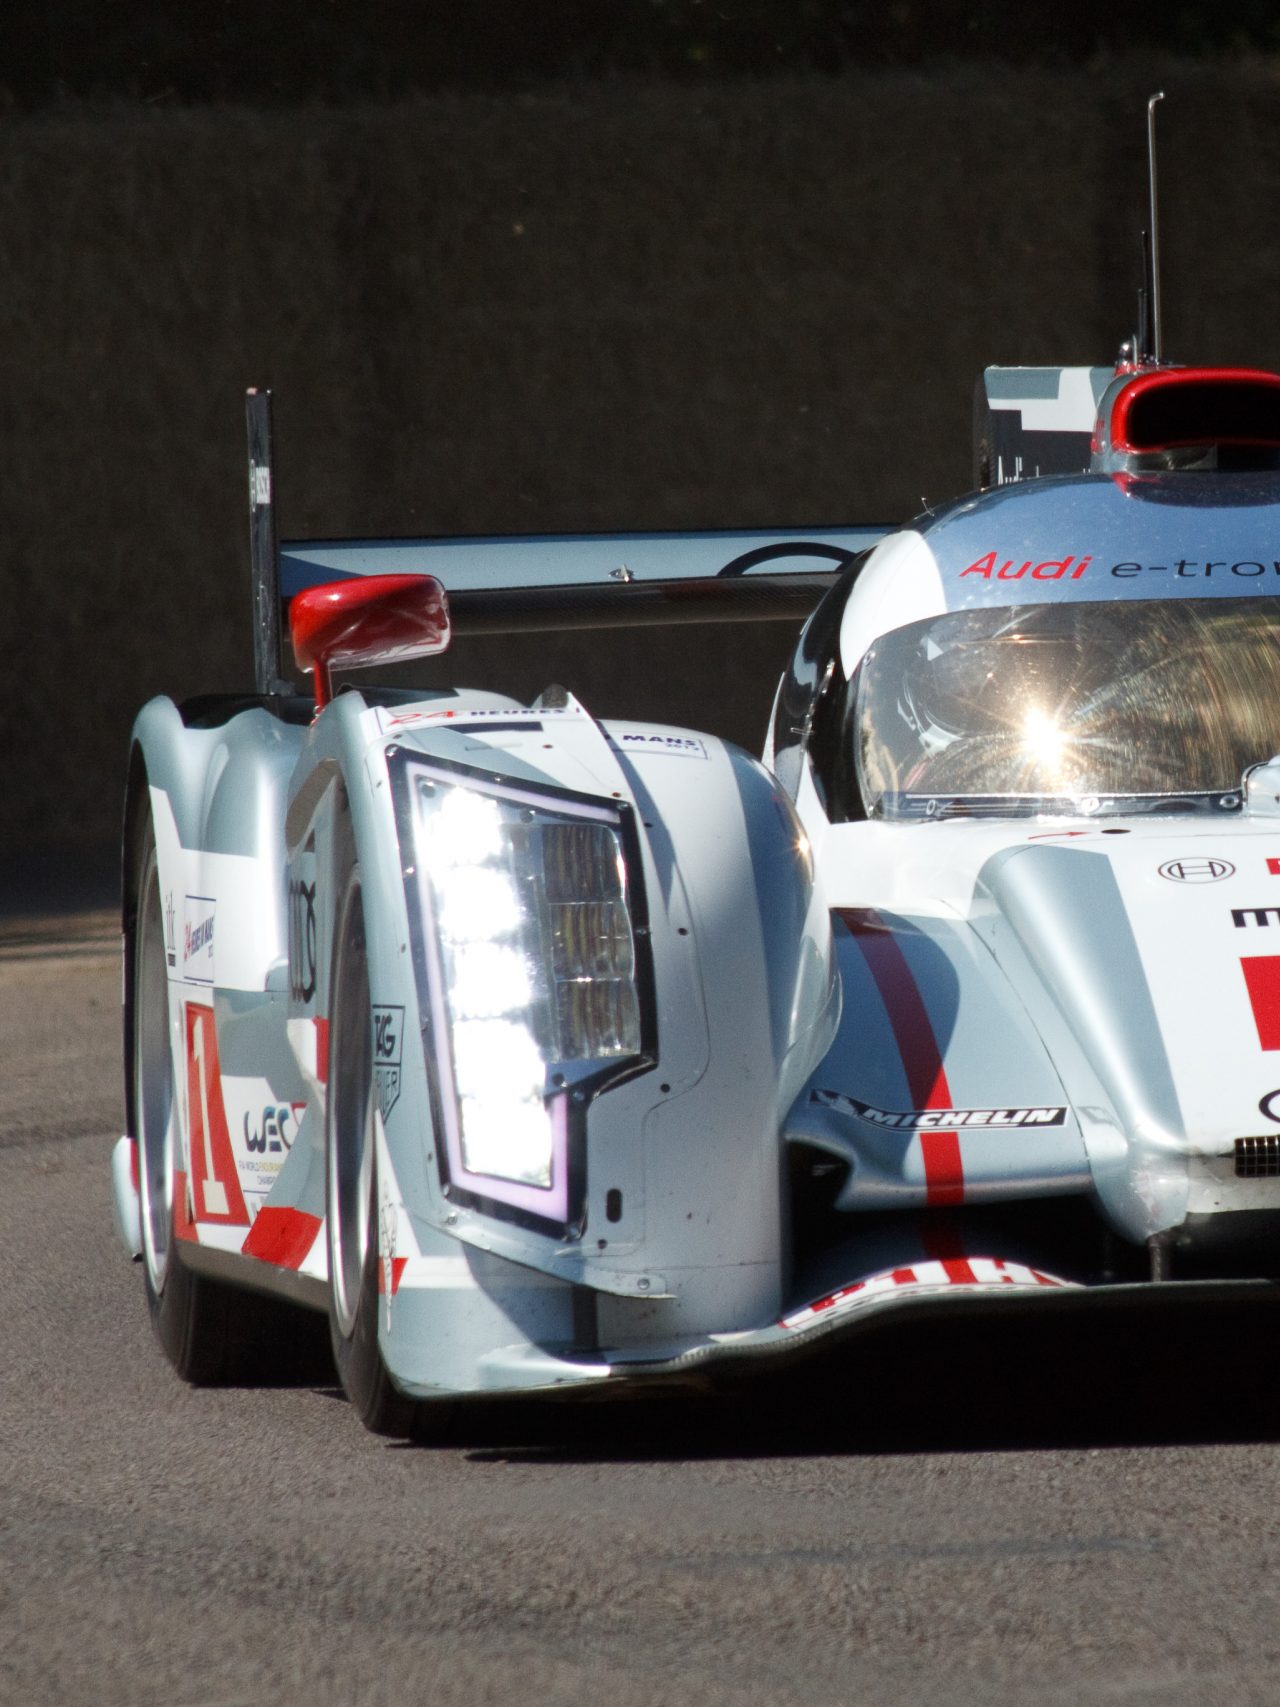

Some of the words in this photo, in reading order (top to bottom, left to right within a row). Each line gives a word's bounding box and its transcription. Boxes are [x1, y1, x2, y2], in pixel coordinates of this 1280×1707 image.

[958, 551, 1094, 581] Audi
[623, 734, 697, 746] MANS
[191, 1015, 231, 1216] 1
[862, 1107, 1060, 1127] MICHELIN
